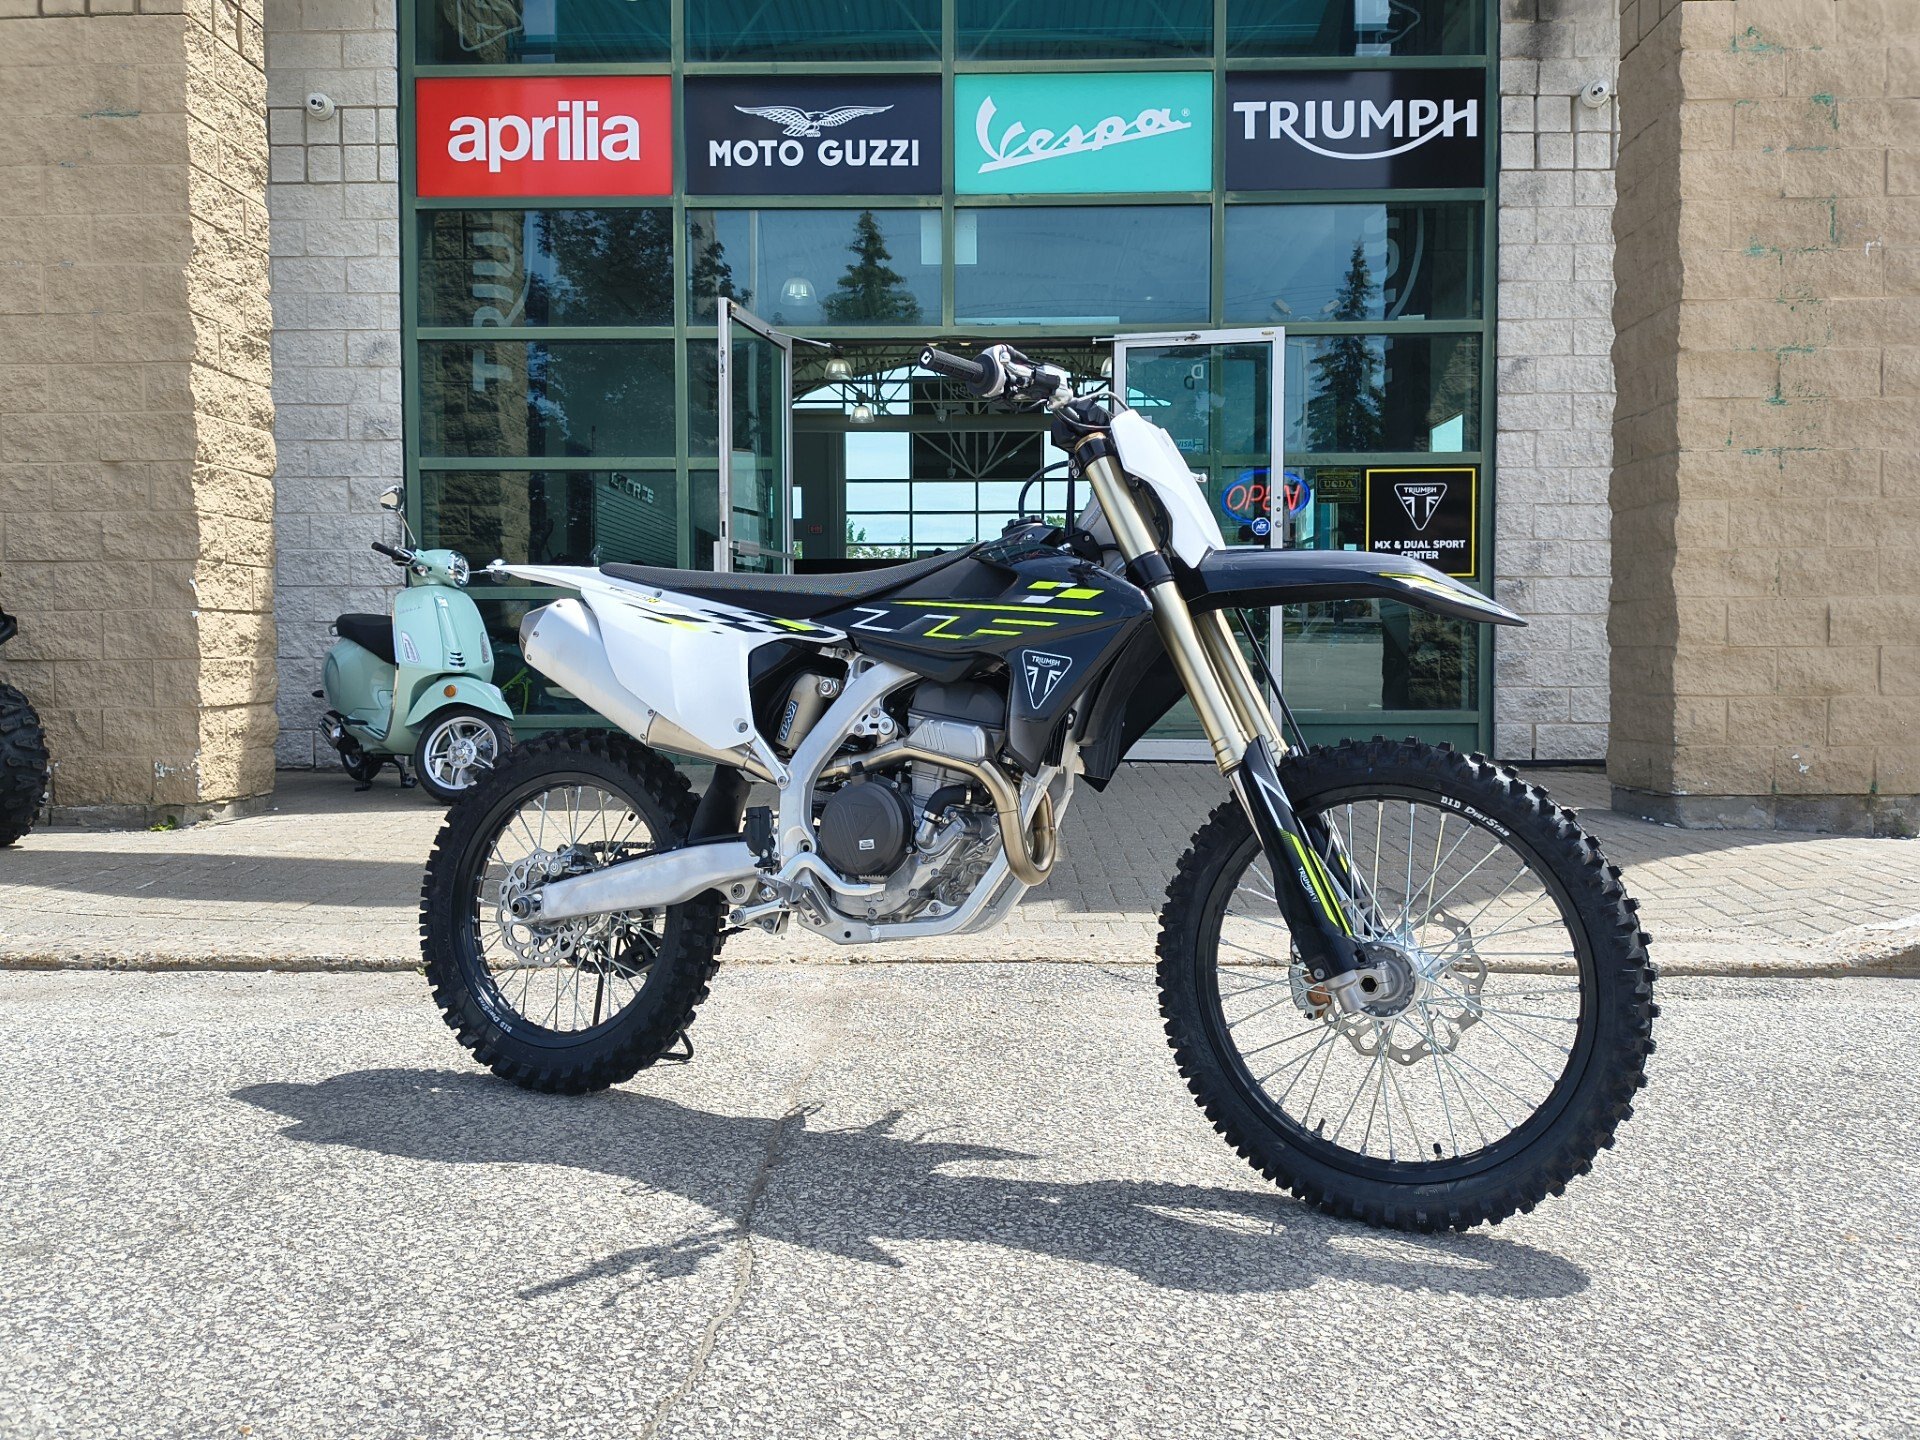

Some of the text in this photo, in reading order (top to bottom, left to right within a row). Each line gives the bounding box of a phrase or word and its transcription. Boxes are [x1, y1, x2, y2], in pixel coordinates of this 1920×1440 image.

[447, 100, 641, 173] aprilia
[976, 95, 1192, 174] Vespa
[1233, 98, 1478, 160] TRIUMPH
[709, 138, 920, 168] MOTO GUZZI
[1404, 486, 1437, 496] TRIUMPH
[1374, 540, 1466, 549] MX & DUAL SPORT
[1401, 551, 1439, 560] CENTER
[1032, 655, 1061, 667] TRIUMPH
